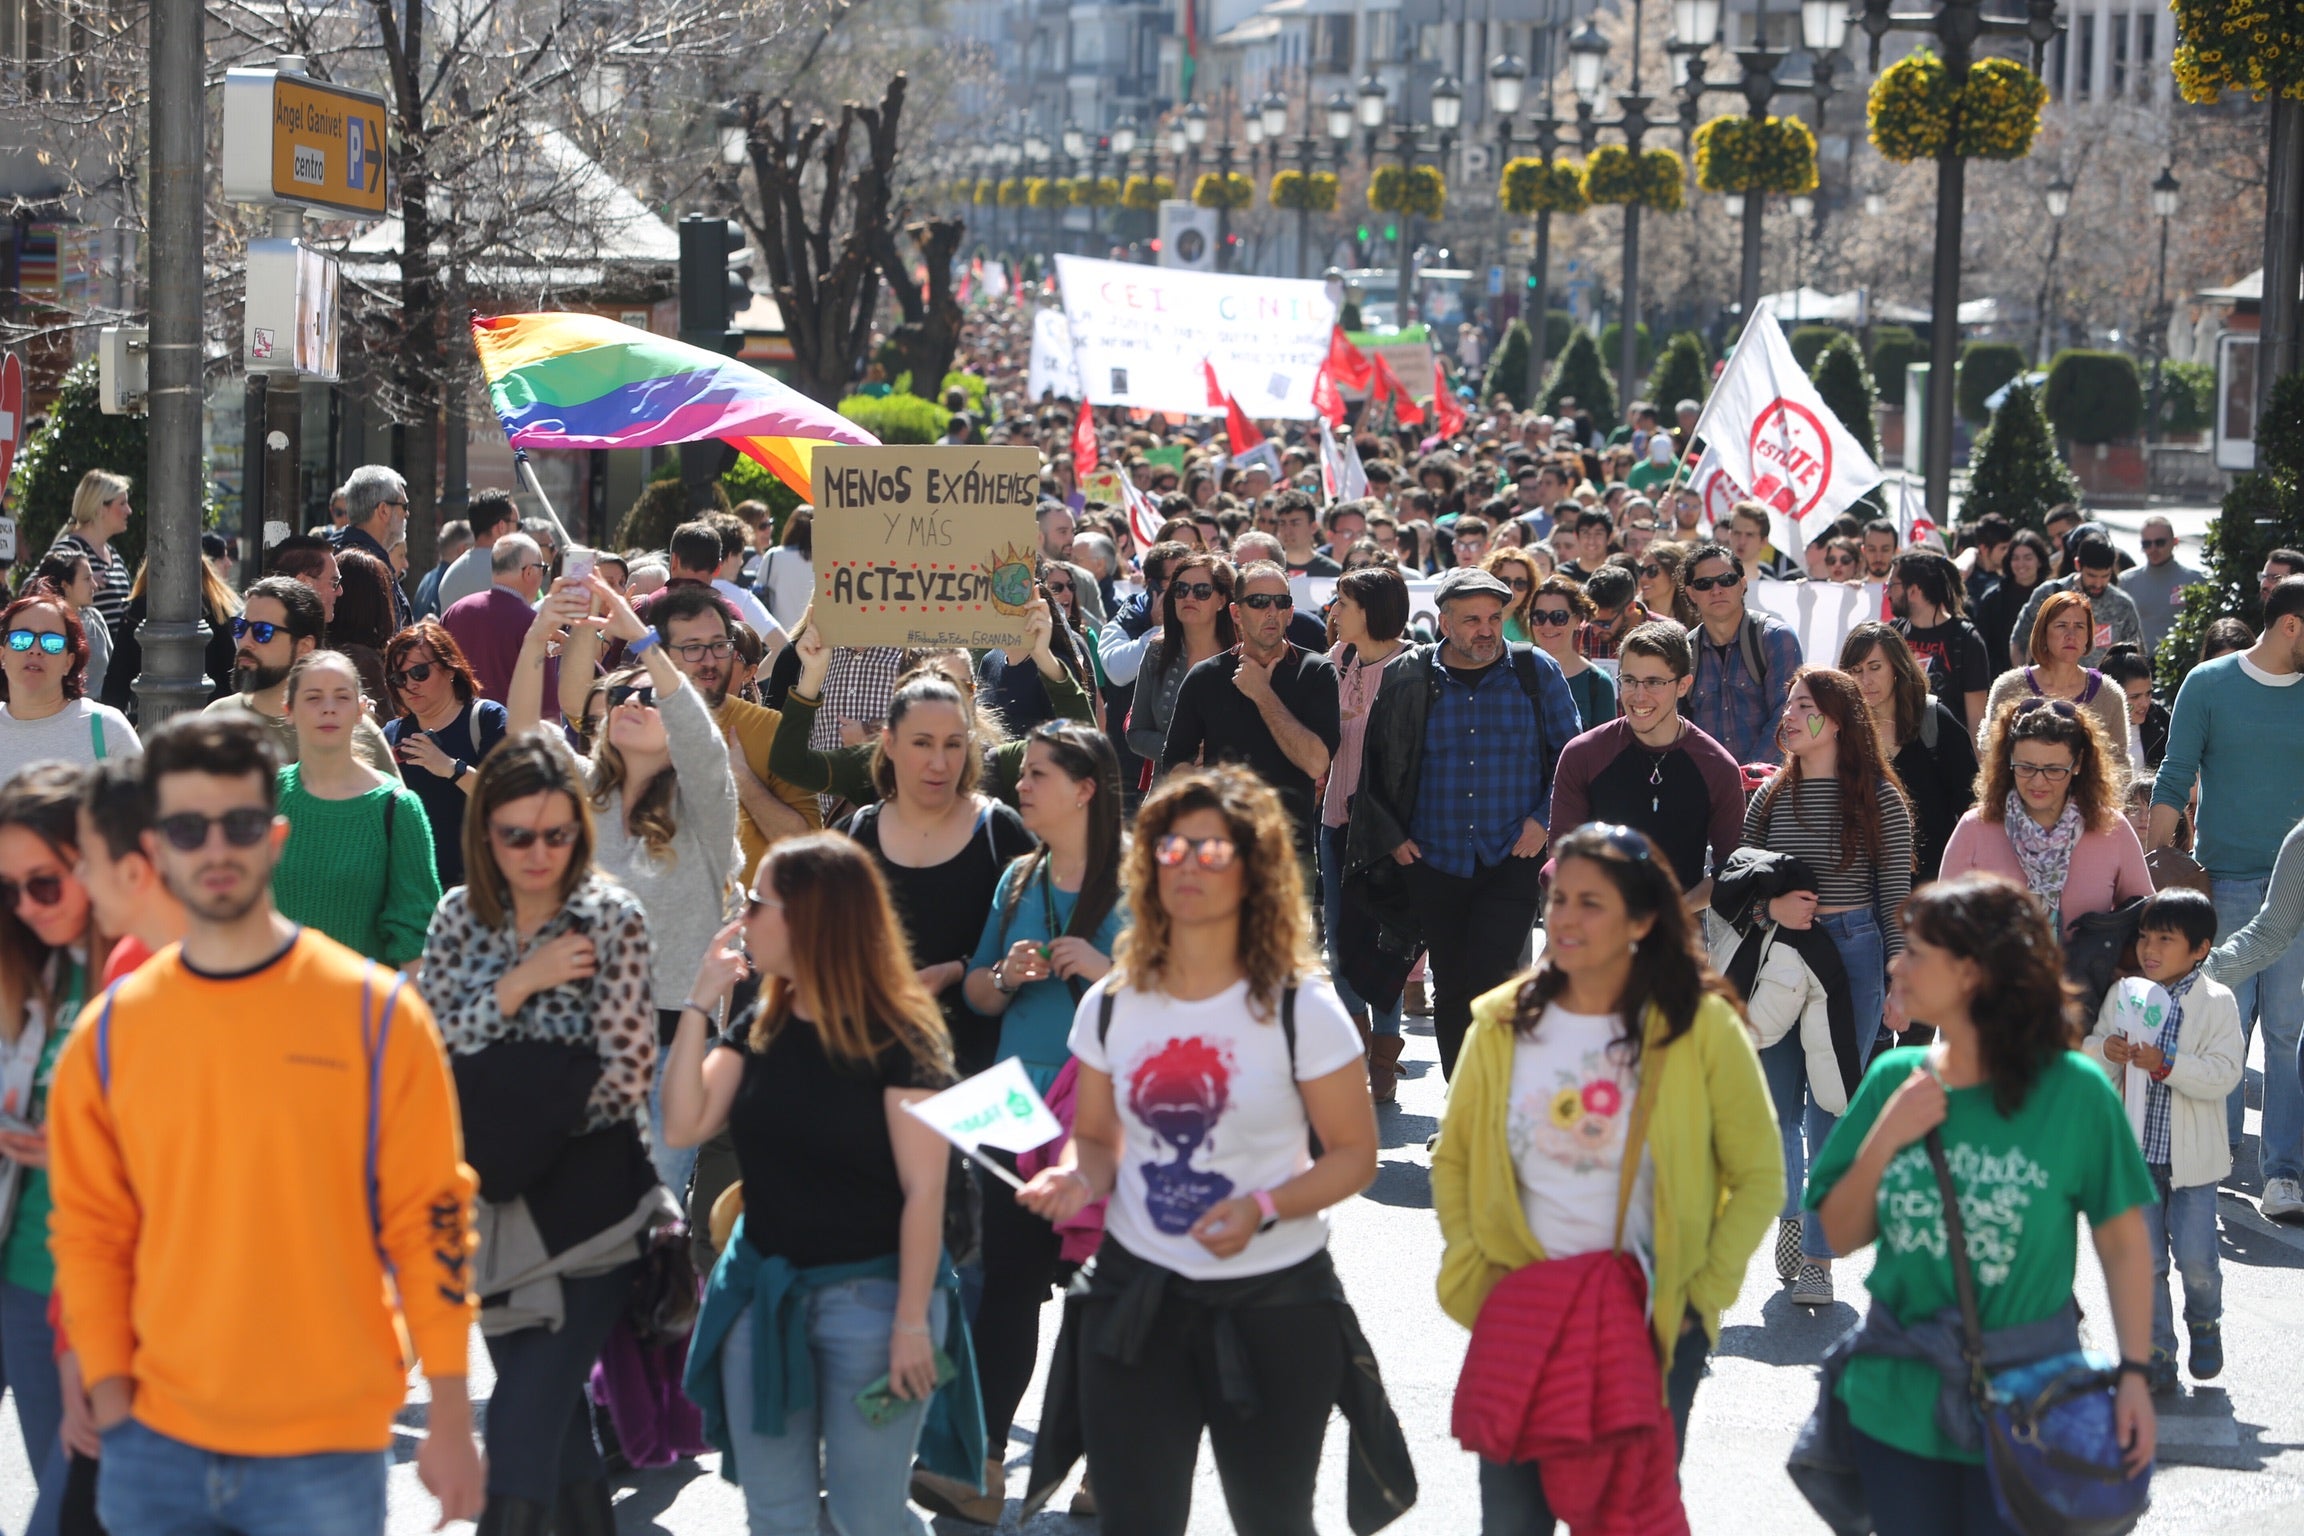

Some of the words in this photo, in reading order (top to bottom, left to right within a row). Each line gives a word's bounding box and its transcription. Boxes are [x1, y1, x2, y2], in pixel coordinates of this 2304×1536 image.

[276, 90, 303, 134] Ángel
[307, 103, 342, 138] Ganivet
[294, 153, 324, 181] centro
[350, 124, 361, 180] P
[825, 465, 912, 508] MENOS
[927, 460, 1038, 506] EXÁMENES
[883, 512, 900, 544] Y
[908, 508, 952, 547] MÁS
[972, 630, 1022, 646] GRANADA
